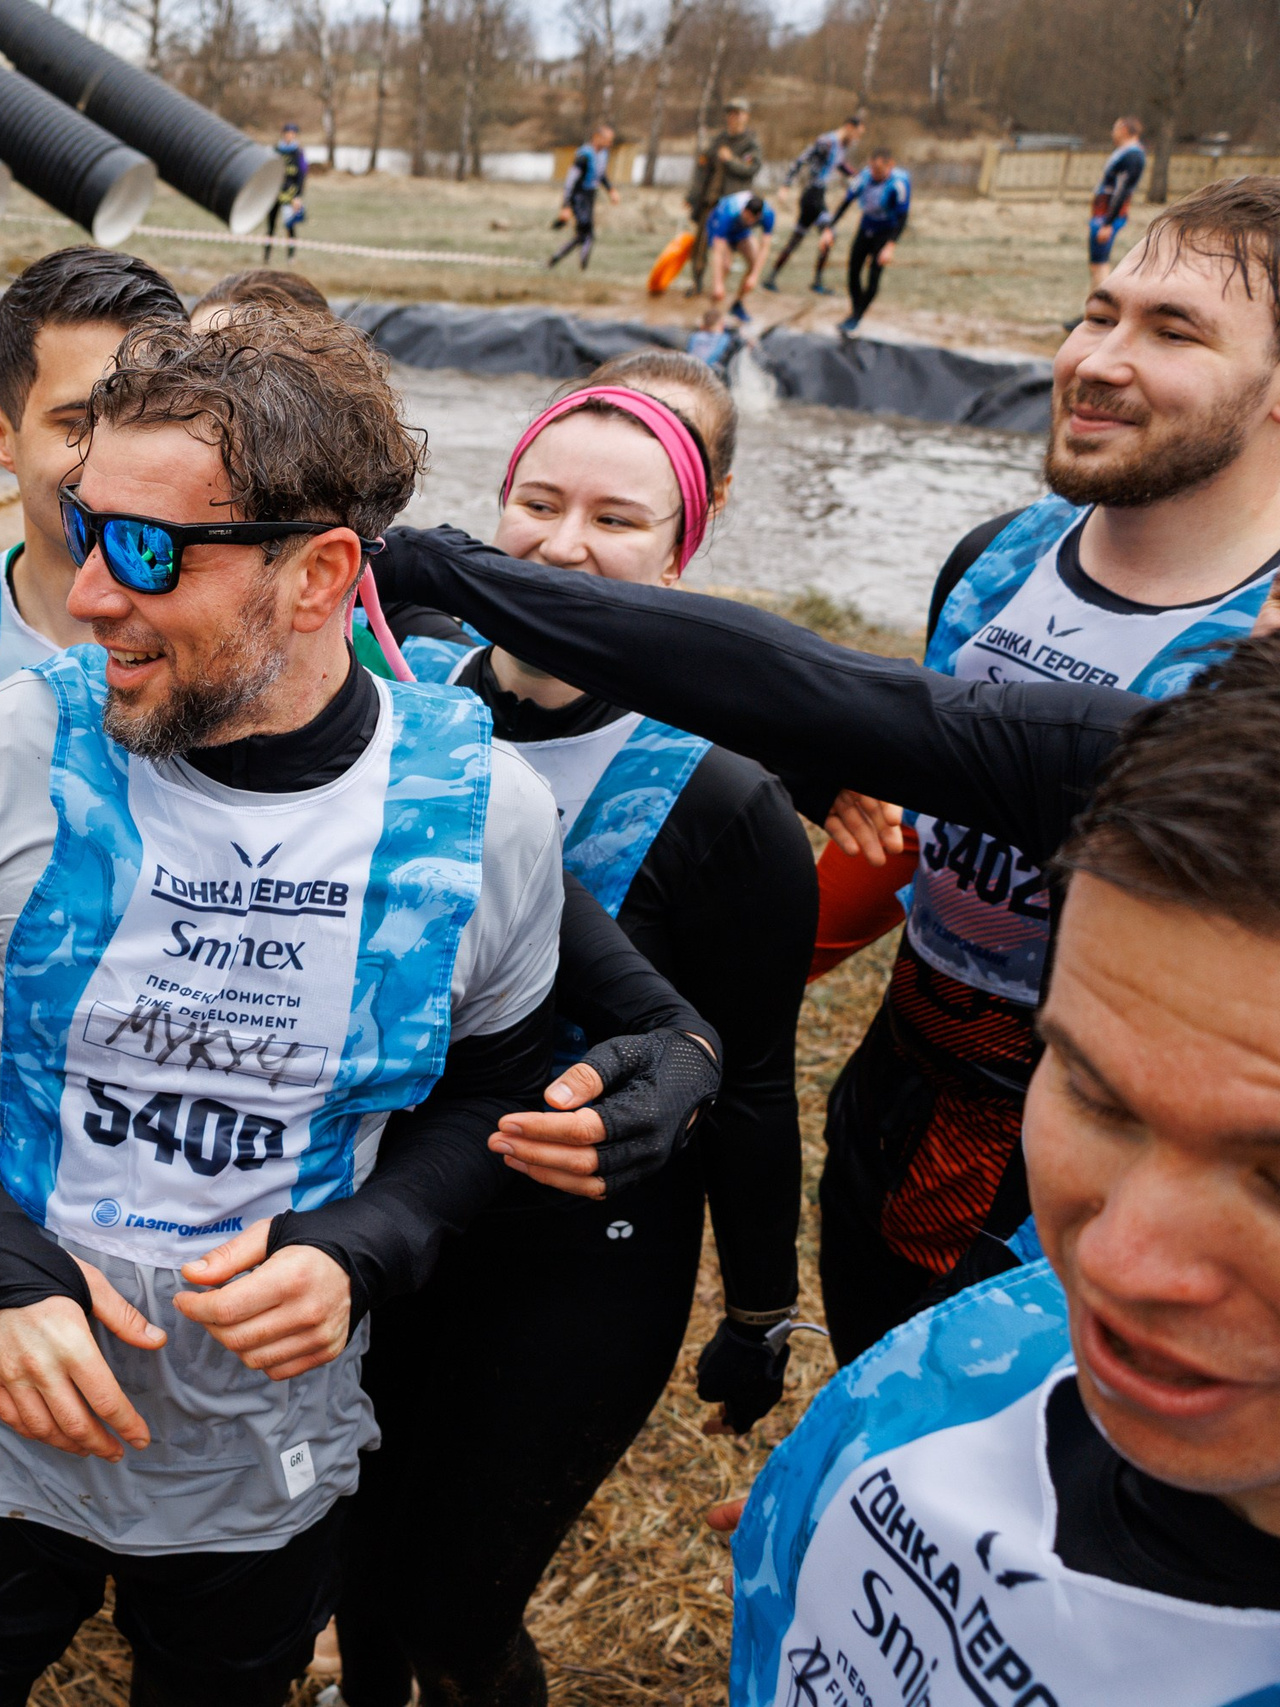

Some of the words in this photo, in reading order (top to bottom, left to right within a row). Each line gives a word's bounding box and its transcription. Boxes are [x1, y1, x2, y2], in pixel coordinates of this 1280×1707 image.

[978, 625, 1033, 658] ГОНКА
[1032, 644, 1120, 688] ГЕРОЕВ
[154, 864, 243, 907] ГОНКА
[135, 994, 173, 1013] FINE
[178, 1006, 298, 1030] DEVELOPMENT
[146, 974, 301, 1008] ПЕРФЕКИОНИСТЫ
[83, 1076, 288, 1178] 5400
[125, 1213, 244, 1237] ГАЗПРОМБАНК
[859, 1467, 960, 1612] ГОНКА
[961, 1595, 1061, 1707] ГЕРО
[852, 1569, 939, 1707] Smi
